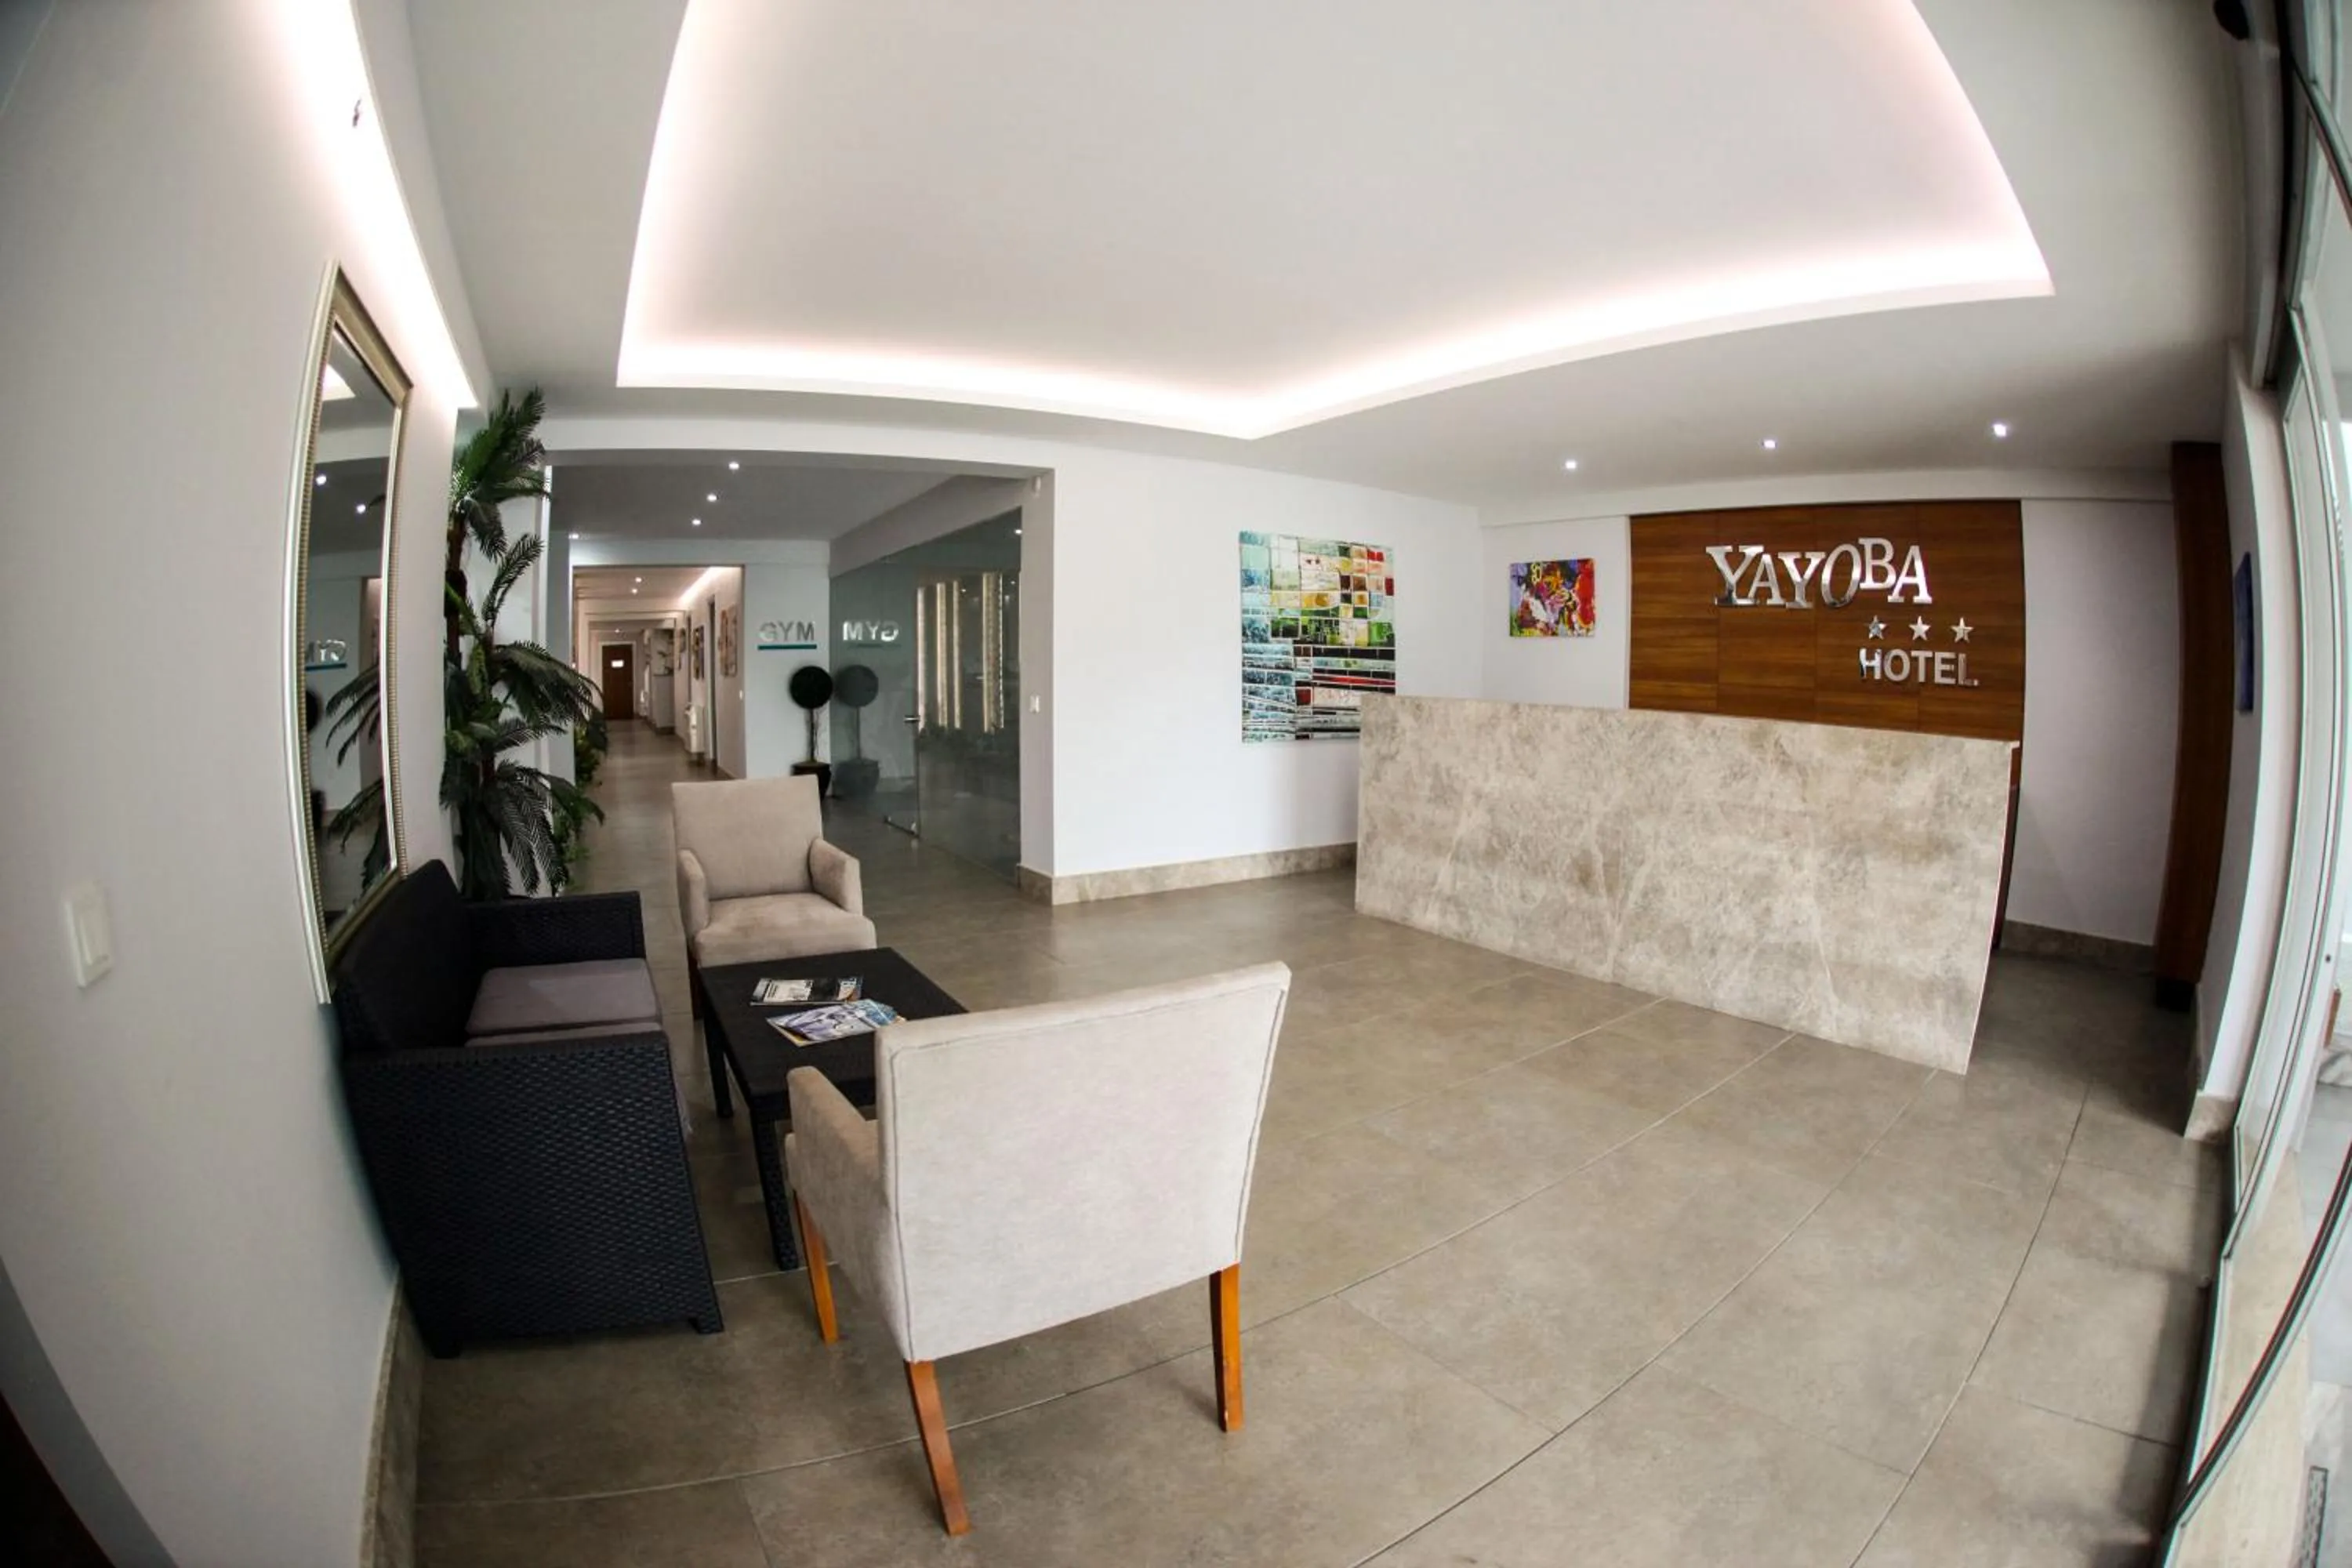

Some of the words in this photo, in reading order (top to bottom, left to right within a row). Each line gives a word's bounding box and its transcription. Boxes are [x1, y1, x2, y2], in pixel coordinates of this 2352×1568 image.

[1705, 537, 1933, 608] YAYOBA
[758, 620, 815, 643] GYM
[1859, 648, 1980, 687] HOTEL
